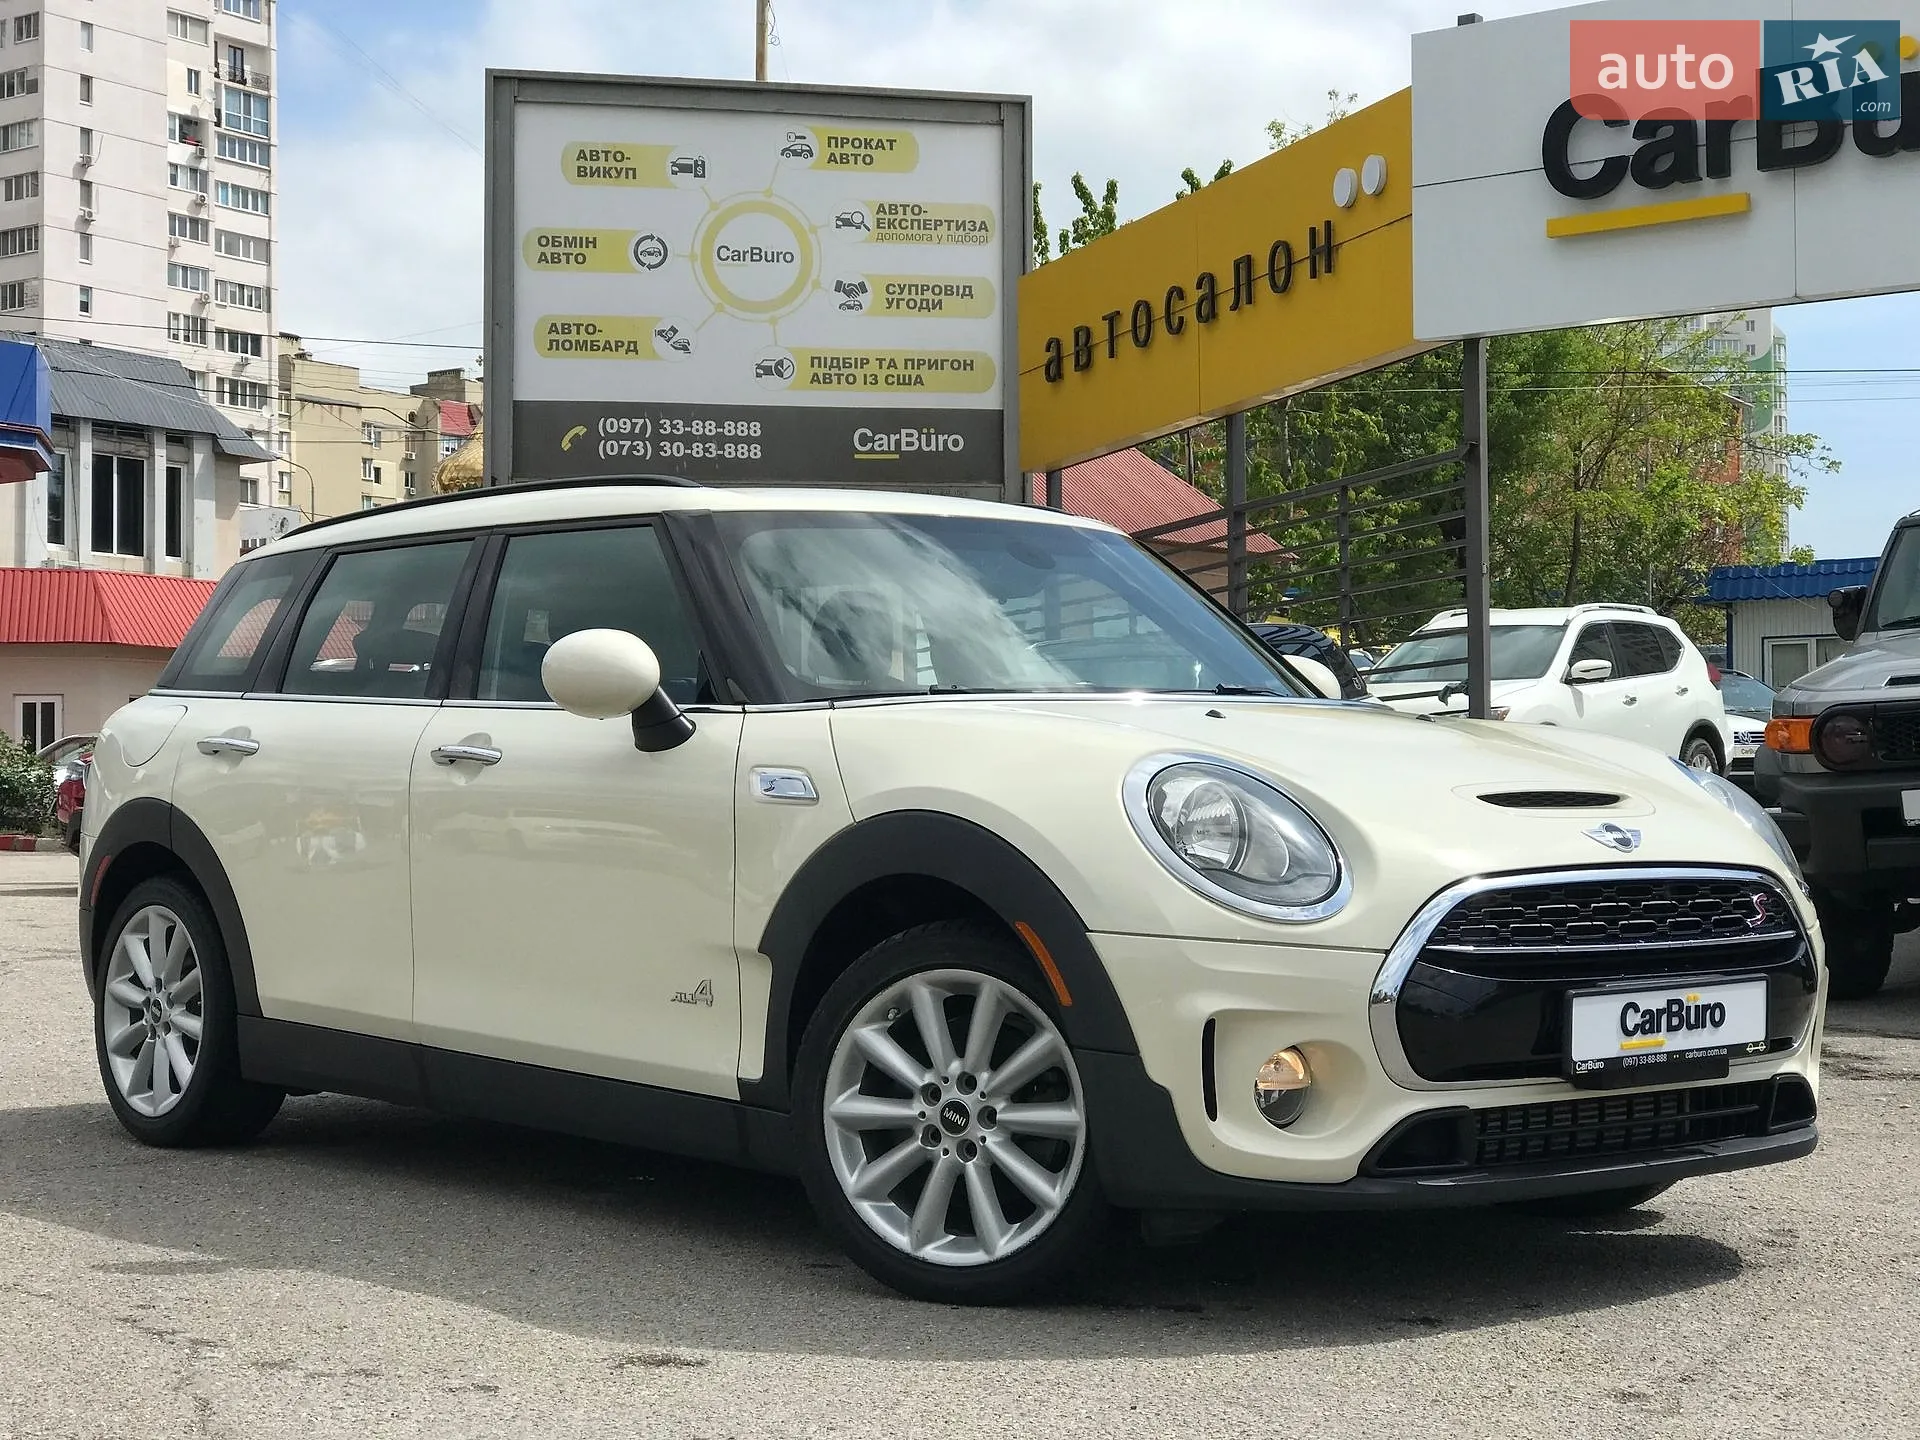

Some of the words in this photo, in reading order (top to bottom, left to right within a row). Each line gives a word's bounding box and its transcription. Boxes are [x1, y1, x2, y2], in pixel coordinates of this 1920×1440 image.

[827, 136, 897, 151] ПРОКАТ
[576, 149, 631, 163] АВТО-
[826, 152, 874, 166] АВТО
[576, 166, 637, 180] ВИКУП
[875, 203, 929, 216] АВТО-
[876, 218, 989, 233] ЕКСПЕРТИЗА
[537, 235, 598, 249] ОБМІН
[875, 232, 933, 243] допомога
[936, 234, 943, 244] у
[946, 232, 989, 245] підборі
[537, 252, 587, 265] АВТО
[885, 283, 974, 299] СУПРОВІД
[885, 298, 943, 312] УГОДИ
[1045, 220, 1334, 383] автосалон
[547, 322, 603, 336] АВТО-
[547, 338, 639, 355] ЛОМБАРД
[810, 356, 870, 372] ПІДБІР
[875, 358, 899, 371] ТА
[903, 358, 975, 371] ПРИГОН
[809, 372, 858, 386] АВТО
[863, 373, 879, 386] ІЗ
[884, 373, 925, 387] США
[598, 417, 652, 438] (097)
[658, 418, 762, 437] 33-88-888
[853, 427, 965, 452] CarBüro
[598, 439, 652, 460] (073)
[658, 440, 762, 459] 30-83-888
[1620, 993, 1727, 1037] CarBüro
[1622, 1056, 1639, 1068] (097)
[1639, 1053, 1668, 1065] 33-88-888
[943, 1107, 967, 1127] MINI
